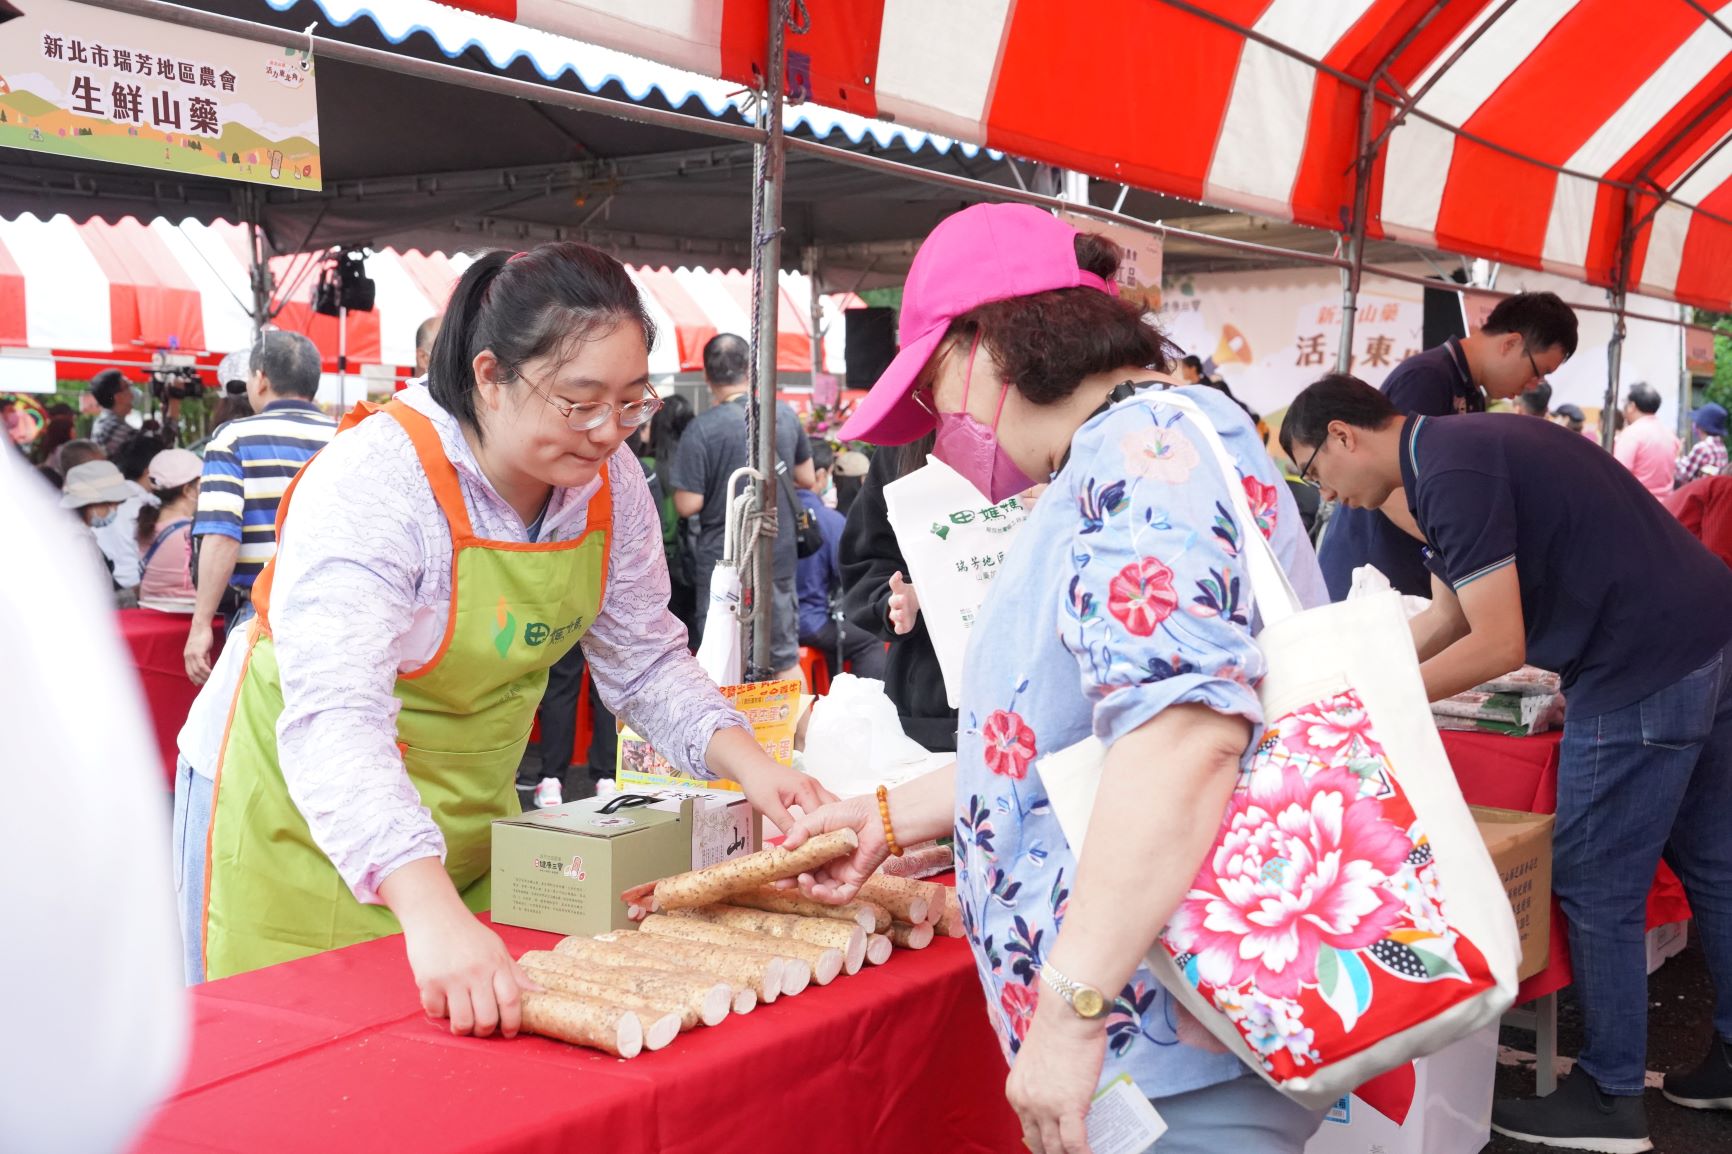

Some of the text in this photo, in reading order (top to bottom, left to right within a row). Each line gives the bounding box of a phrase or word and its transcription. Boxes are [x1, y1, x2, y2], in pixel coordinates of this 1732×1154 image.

[43, 34, 237, 92] 新北市瑞芳地區農會
[71, 76, 220, 135] 生鮮山藥
[1315, 303, 1399, 325] 新山藥
